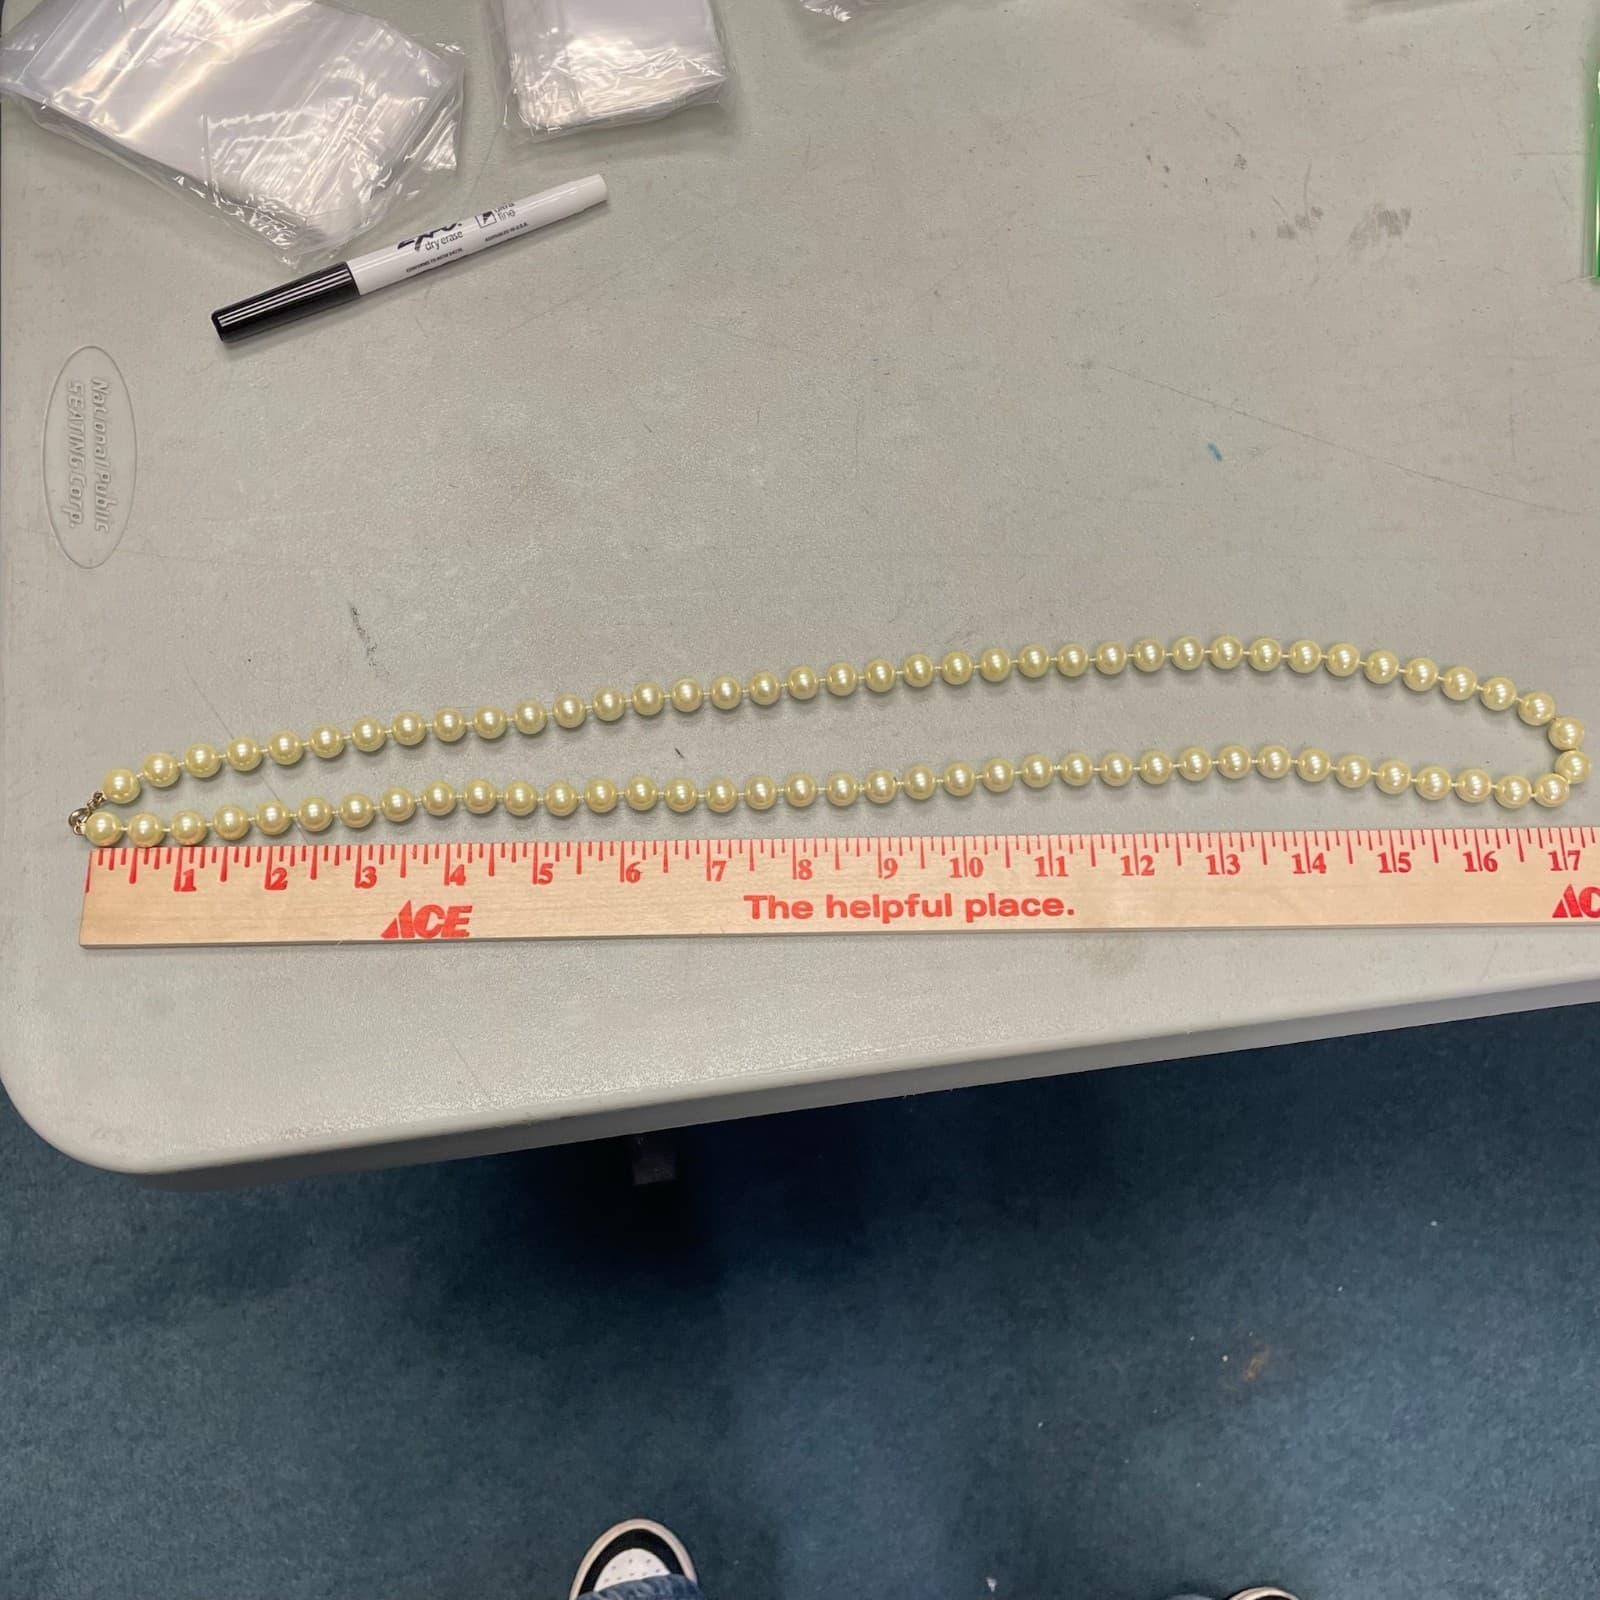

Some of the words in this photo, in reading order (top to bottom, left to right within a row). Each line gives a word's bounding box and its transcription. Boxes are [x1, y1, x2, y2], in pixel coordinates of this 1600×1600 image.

[424, 237, 440, 251] dry
[441, 230, 463, 245] erase
[67, 379, 85, 469] SEATING
[91, 377, 110, 467] National
[60, 470, 87, 529] Corp.
[95, 468, 118, 533] Public
[180, 868, 197, 892] 1
[271, 867, 288, 890] 2
[360, 866, 378, 889] 3
[449, 864, 467, 886] 4
[538, 862, 554, 885] 5
[625, 861, 641, 883] 6
[711, 860, 727, 882] 7
[797, 859, 813, 880] 8
[882, 858, 898, 880] 9
[949, 857, 984, 879] 10
[1034, 856, 1069, 877] 11
[1120, 855, 1155, 876] 12
[1205, 853, 1241, 875] 13
[1291, 852, 1327, 874] 14
[1377, 851, 1412, 873] 15
[1462, 850, 1498, 873] 16
[1547, 850, 1581, 872] 17
[380, 900, 473, 939] ACE
[743, 894, 814, 920] The
[826, 892, 952, 924] helpful
[965, 892, 1075, 923] place.
